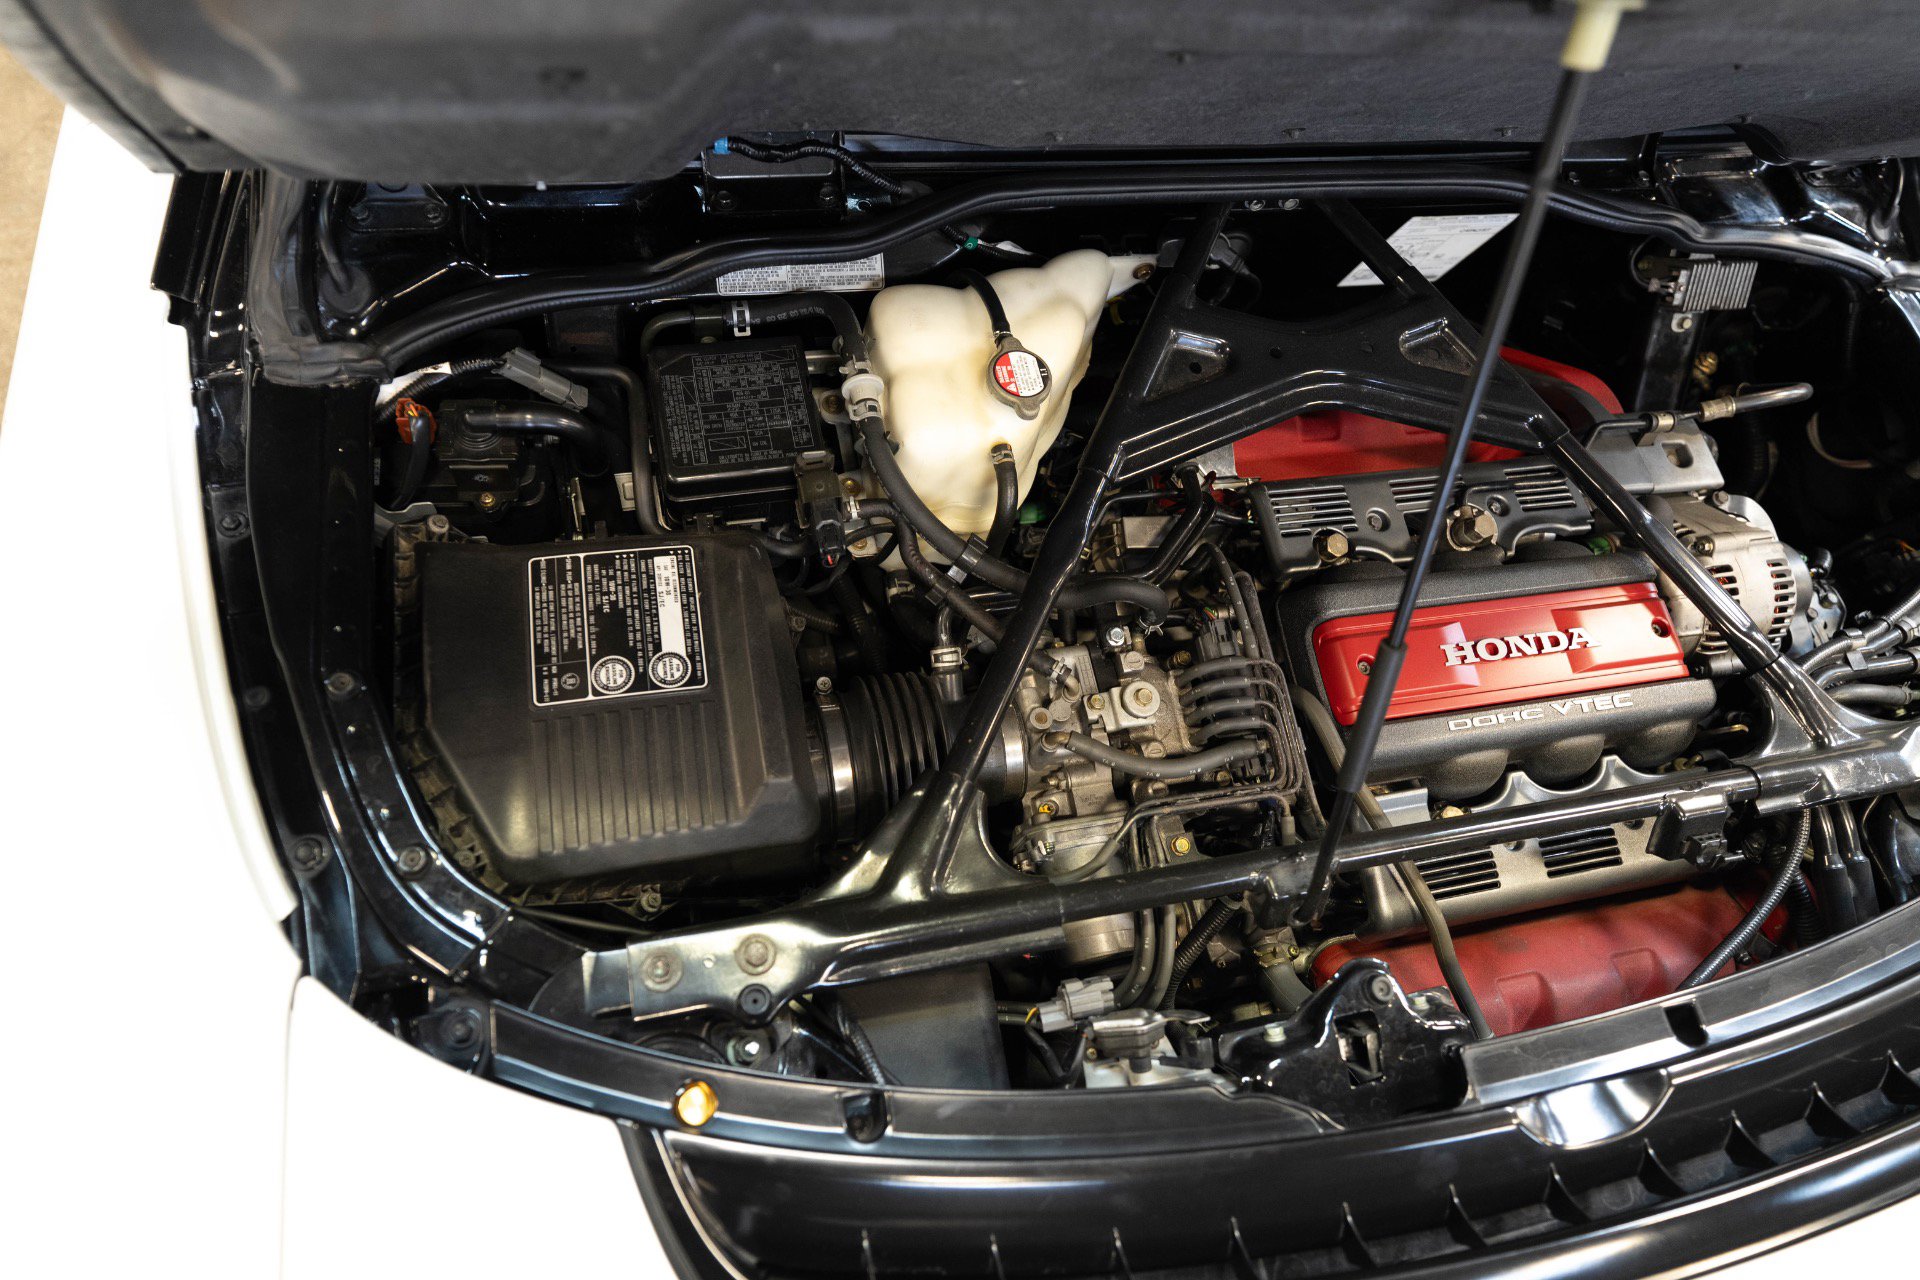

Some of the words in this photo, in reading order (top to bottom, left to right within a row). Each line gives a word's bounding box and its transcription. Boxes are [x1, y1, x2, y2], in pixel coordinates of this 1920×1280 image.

[1440, 627, 1601, 666] HONDA
[1448, 707, 1544, 731] DOHC
[1550, 693, 1634, 716] VTEC
